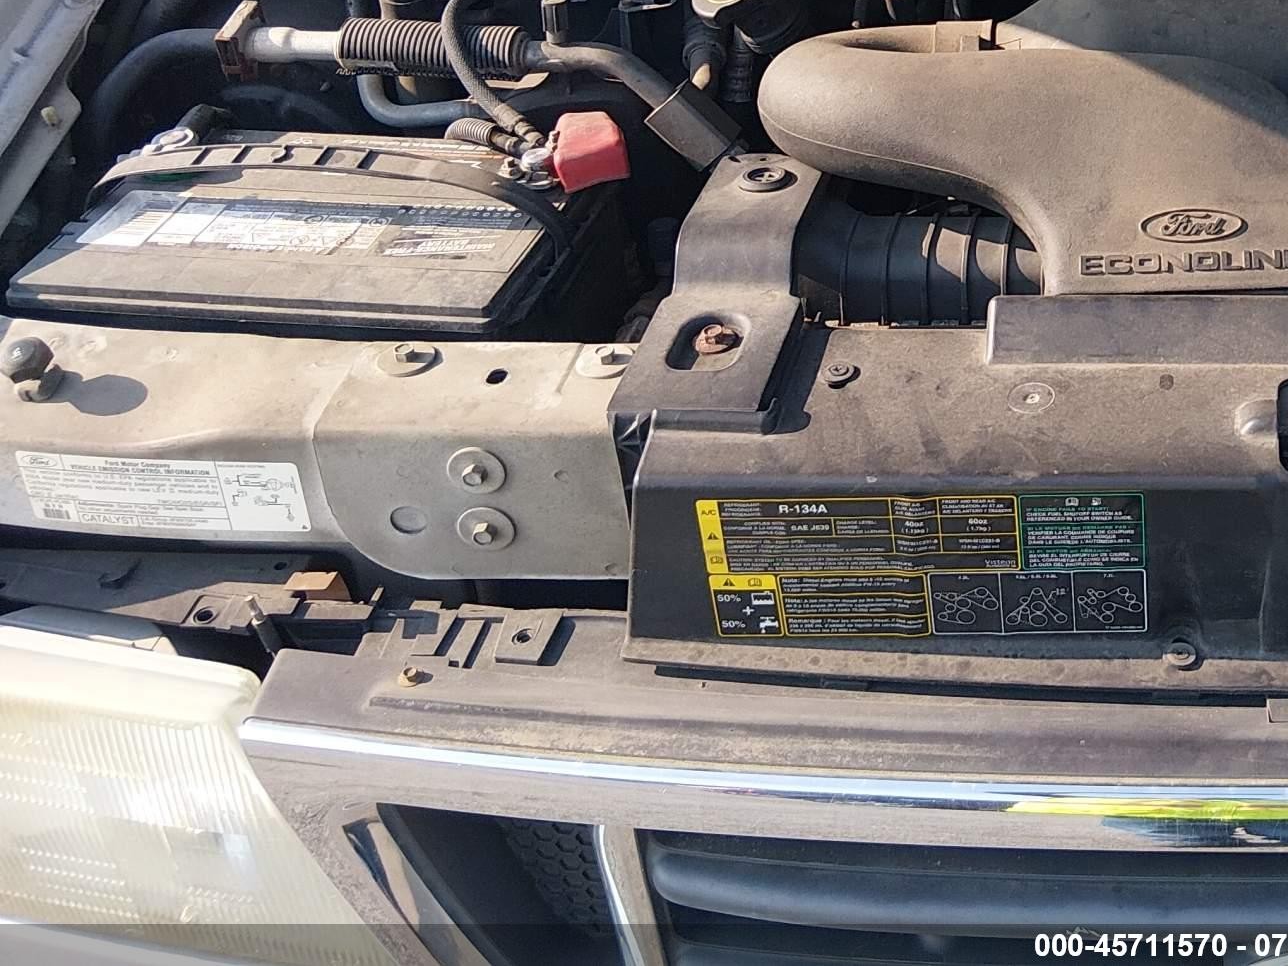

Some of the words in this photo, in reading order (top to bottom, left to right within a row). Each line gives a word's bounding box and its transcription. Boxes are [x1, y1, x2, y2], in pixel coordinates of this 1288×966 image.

[1162, 213, 1227, 235] Ford
[29, 457, 50, 465] Ford
[141, 461, 171, 469] Company
[164, 468, 211, 476] INFORMATION
[778, 504, 828, 513] R-134A
[81, 514, 134, 525] CATALYST
[717, 594, 742, 602] 50%
[722, 620, 746, 628] 50%
